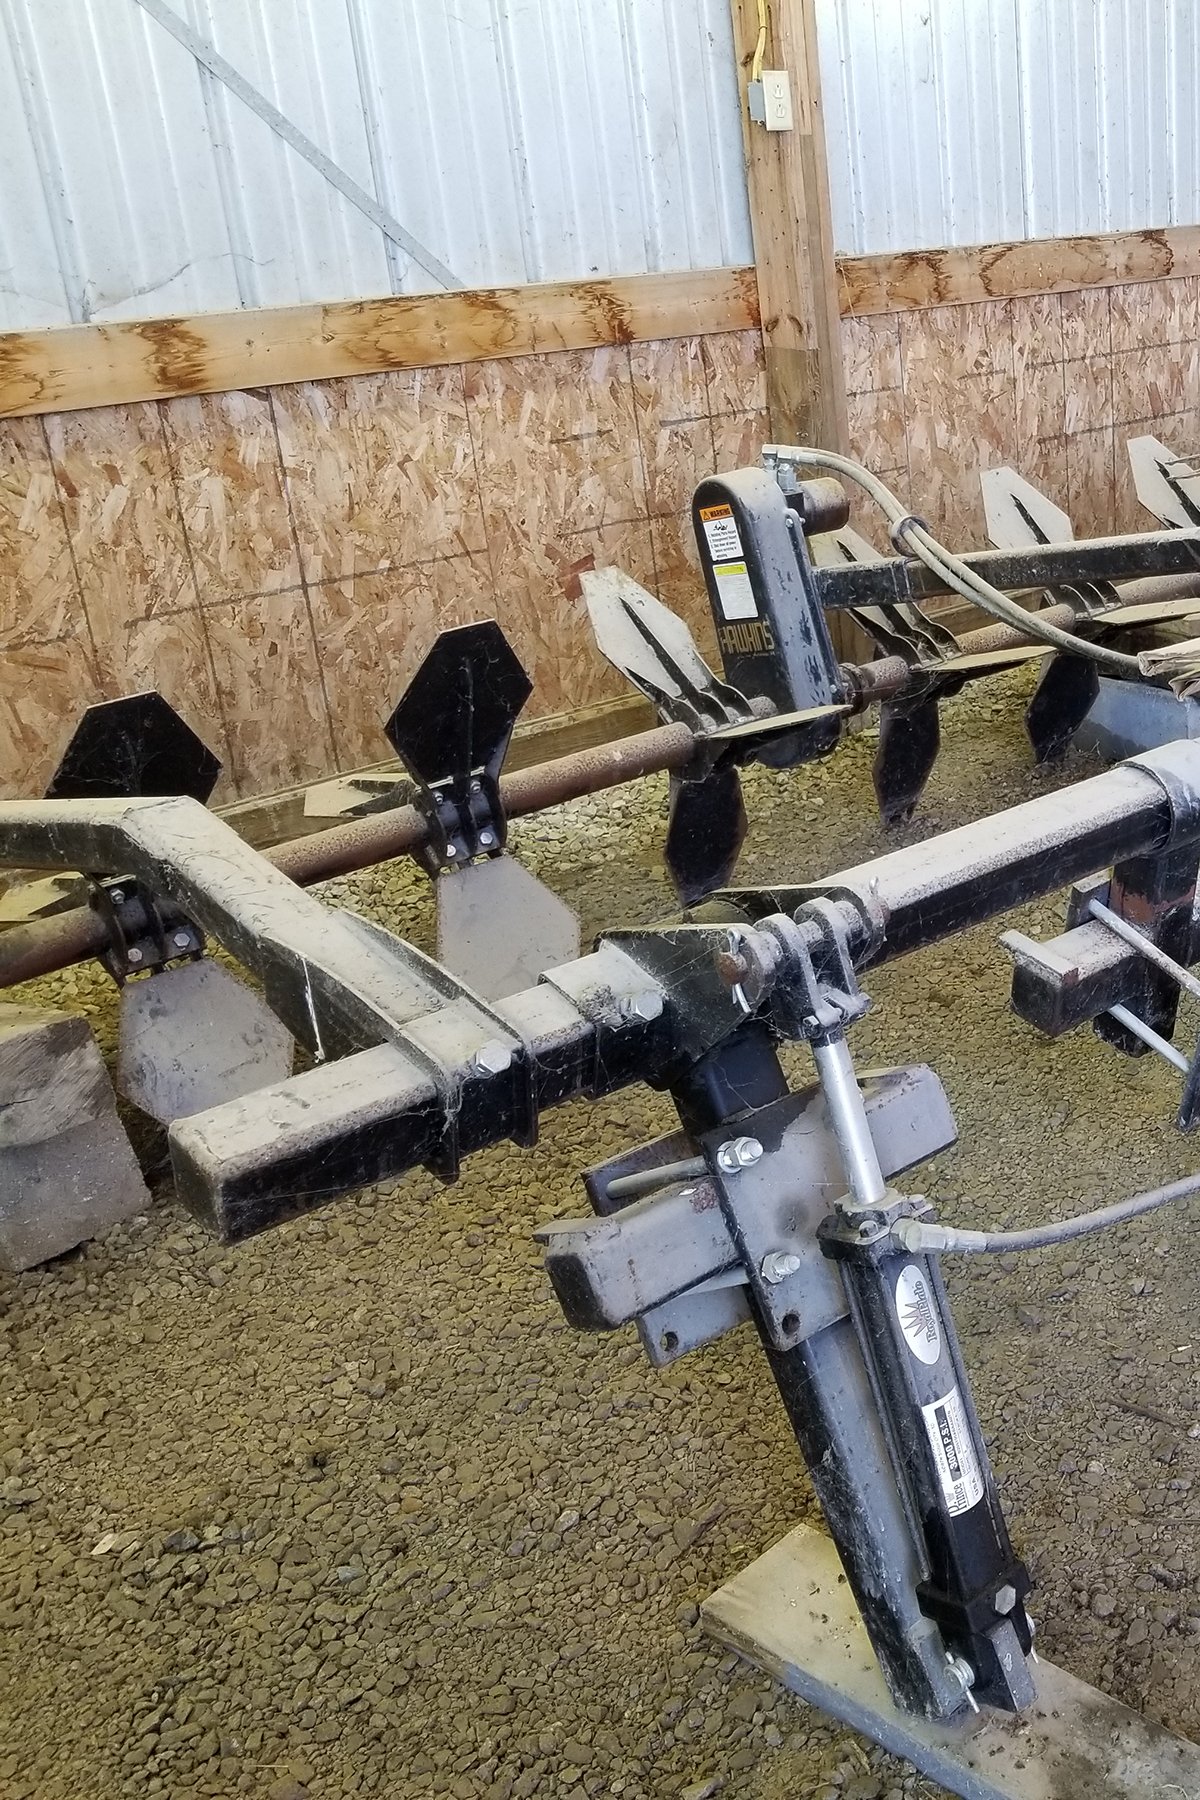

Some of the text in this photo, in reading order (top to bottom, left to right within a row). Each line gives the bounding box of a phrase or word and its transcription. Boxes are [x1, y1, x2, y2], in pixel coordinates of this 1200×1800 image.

[718, 622, 775, 654] HAWKINS
[940, 1419, 951, 1444] P.S.I.
[945, 1445, 957, 1470] 3000
[948, 1482, 967, 1515] Prince
